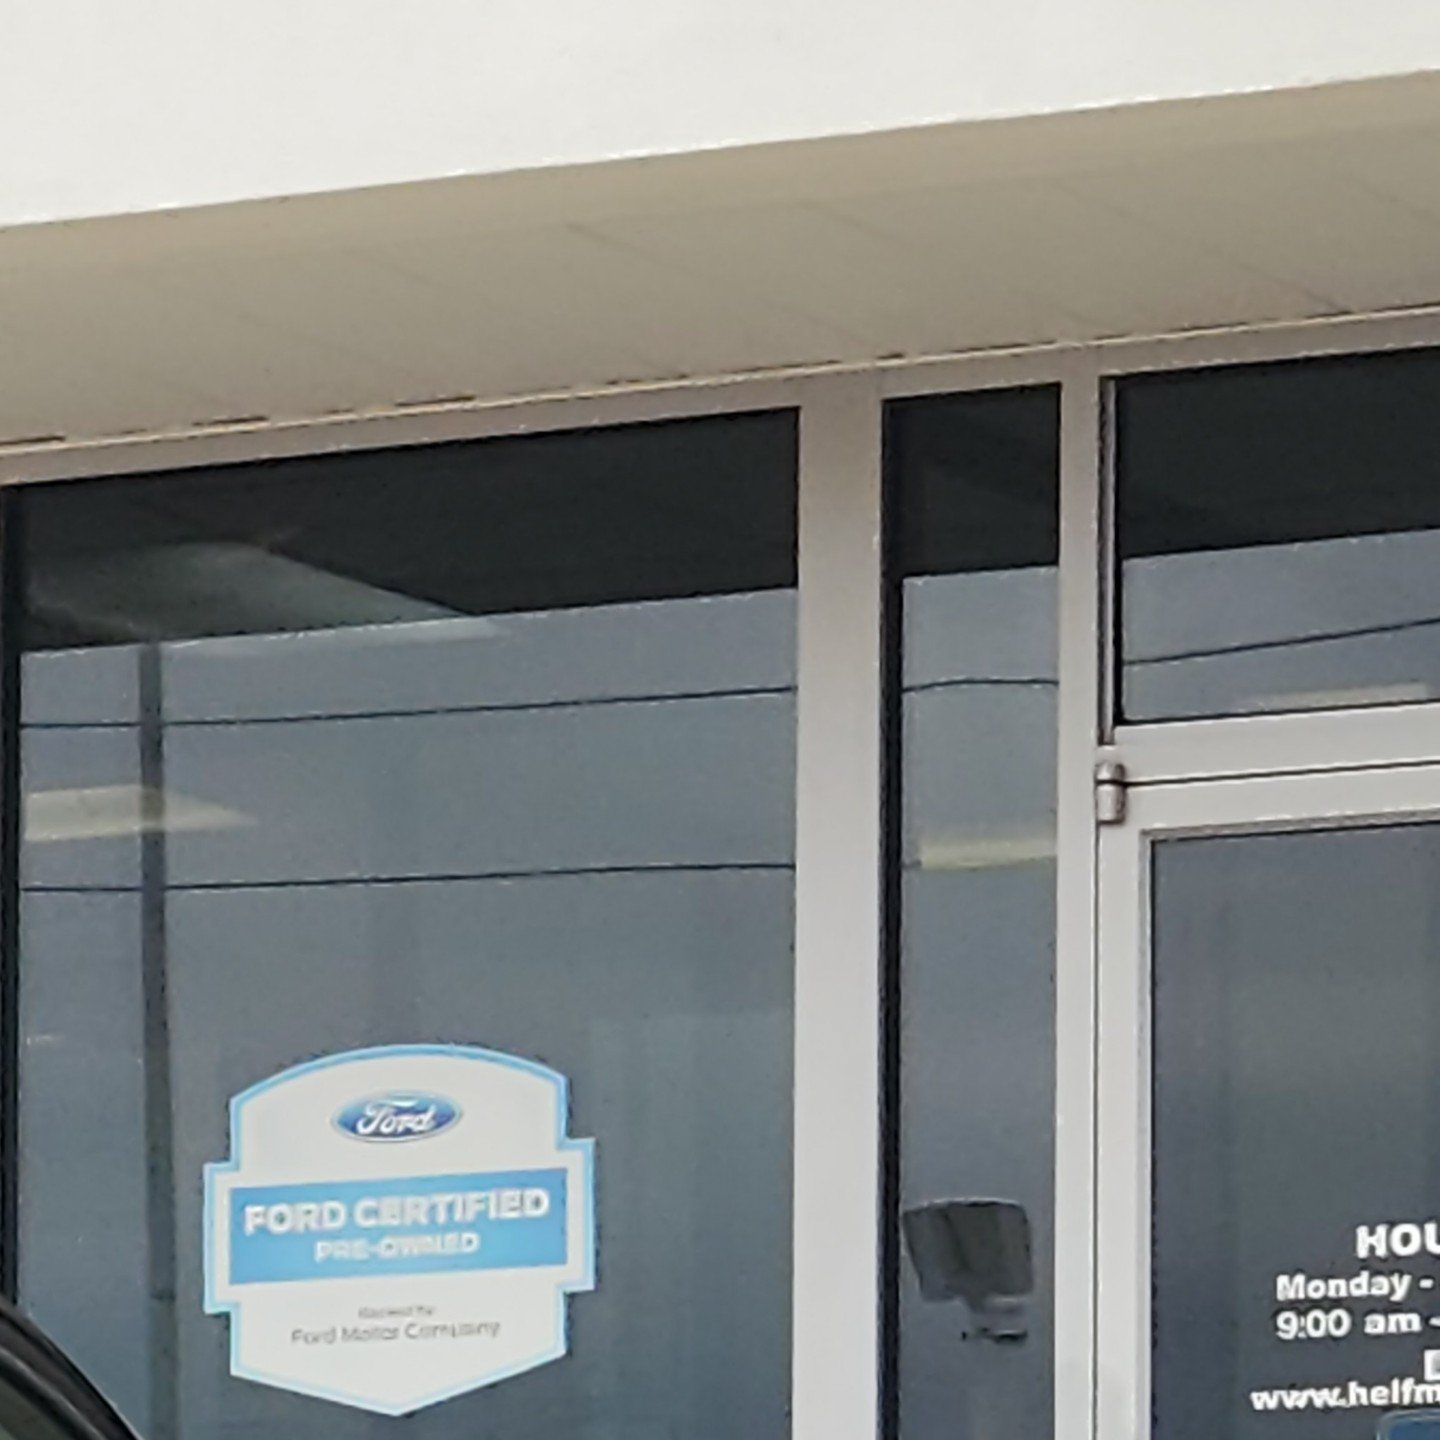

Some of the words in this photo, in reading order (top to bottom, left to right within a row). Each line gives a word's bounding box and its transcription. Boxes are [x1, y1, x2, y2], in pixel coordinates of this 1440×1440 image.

[355, 1101, 436, 1136] Ford
[244, 1200, 346, 1236] FORD
[353, 1187, 551, 1228] CERTIFIED
[313, 1231, 481, 1263] PRE-OWNED
[1276, 1270, 1412, 1303] Monday
[1275, 1308, 1353, 1340] 9:00
[1364, 1312, 1422, 1336] am
